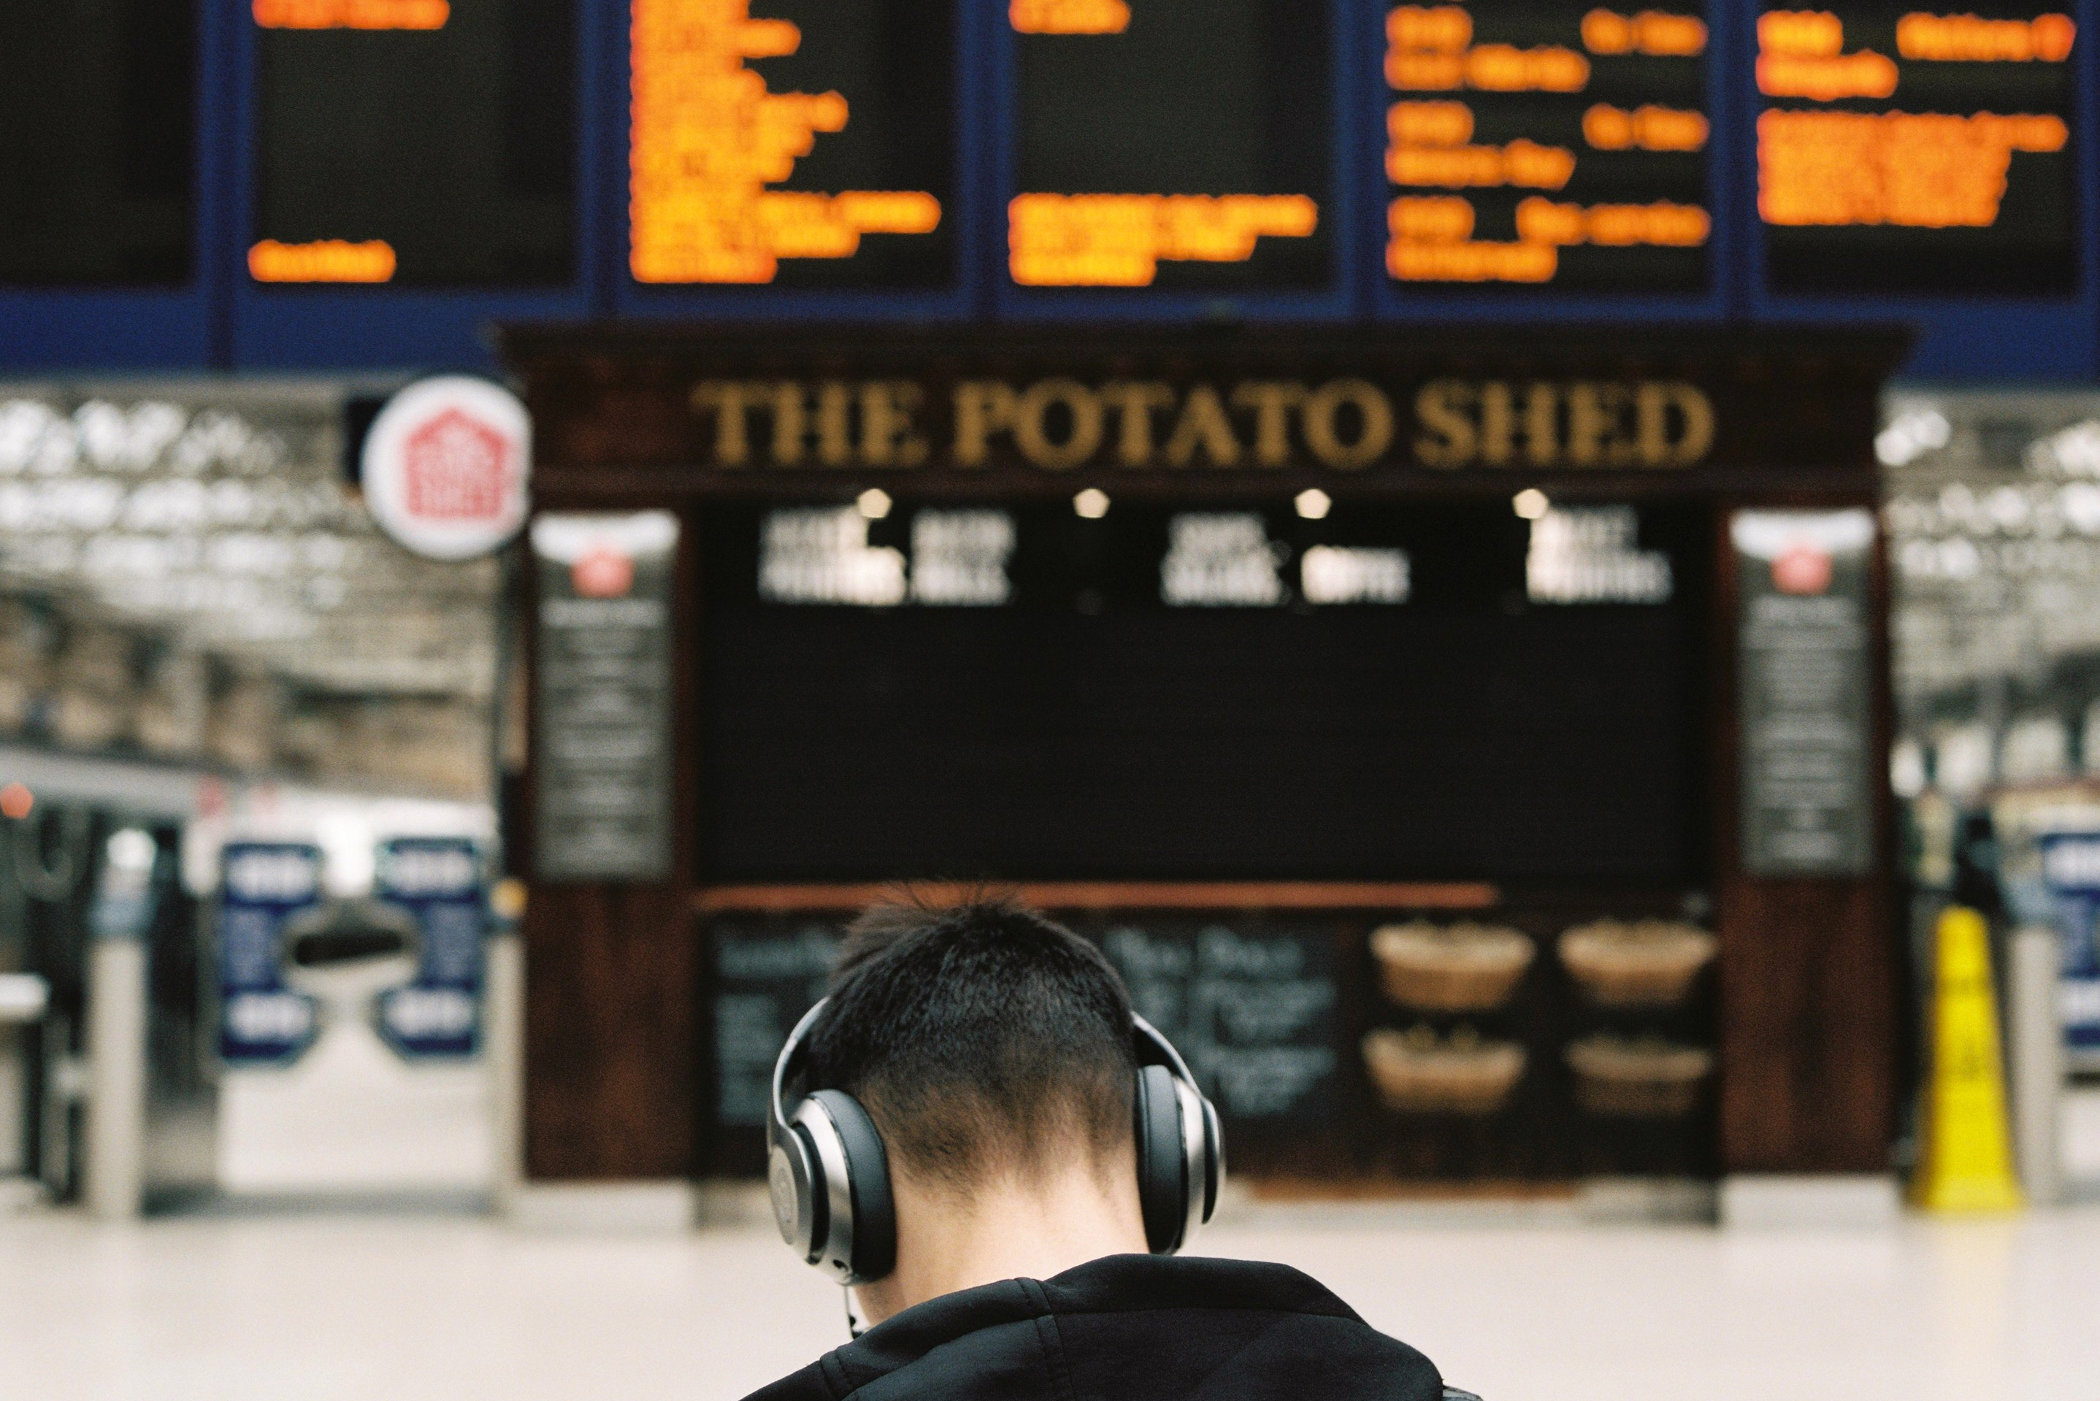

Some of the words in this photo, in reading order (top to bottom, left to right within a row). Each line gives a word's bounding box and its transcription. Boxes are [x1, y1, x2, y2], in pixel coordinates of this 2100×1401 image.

[694, 380, 927, 468] THE
[954, 379, 1393, 470] POTATO
[1413, 379, 1715, 469] SHED
